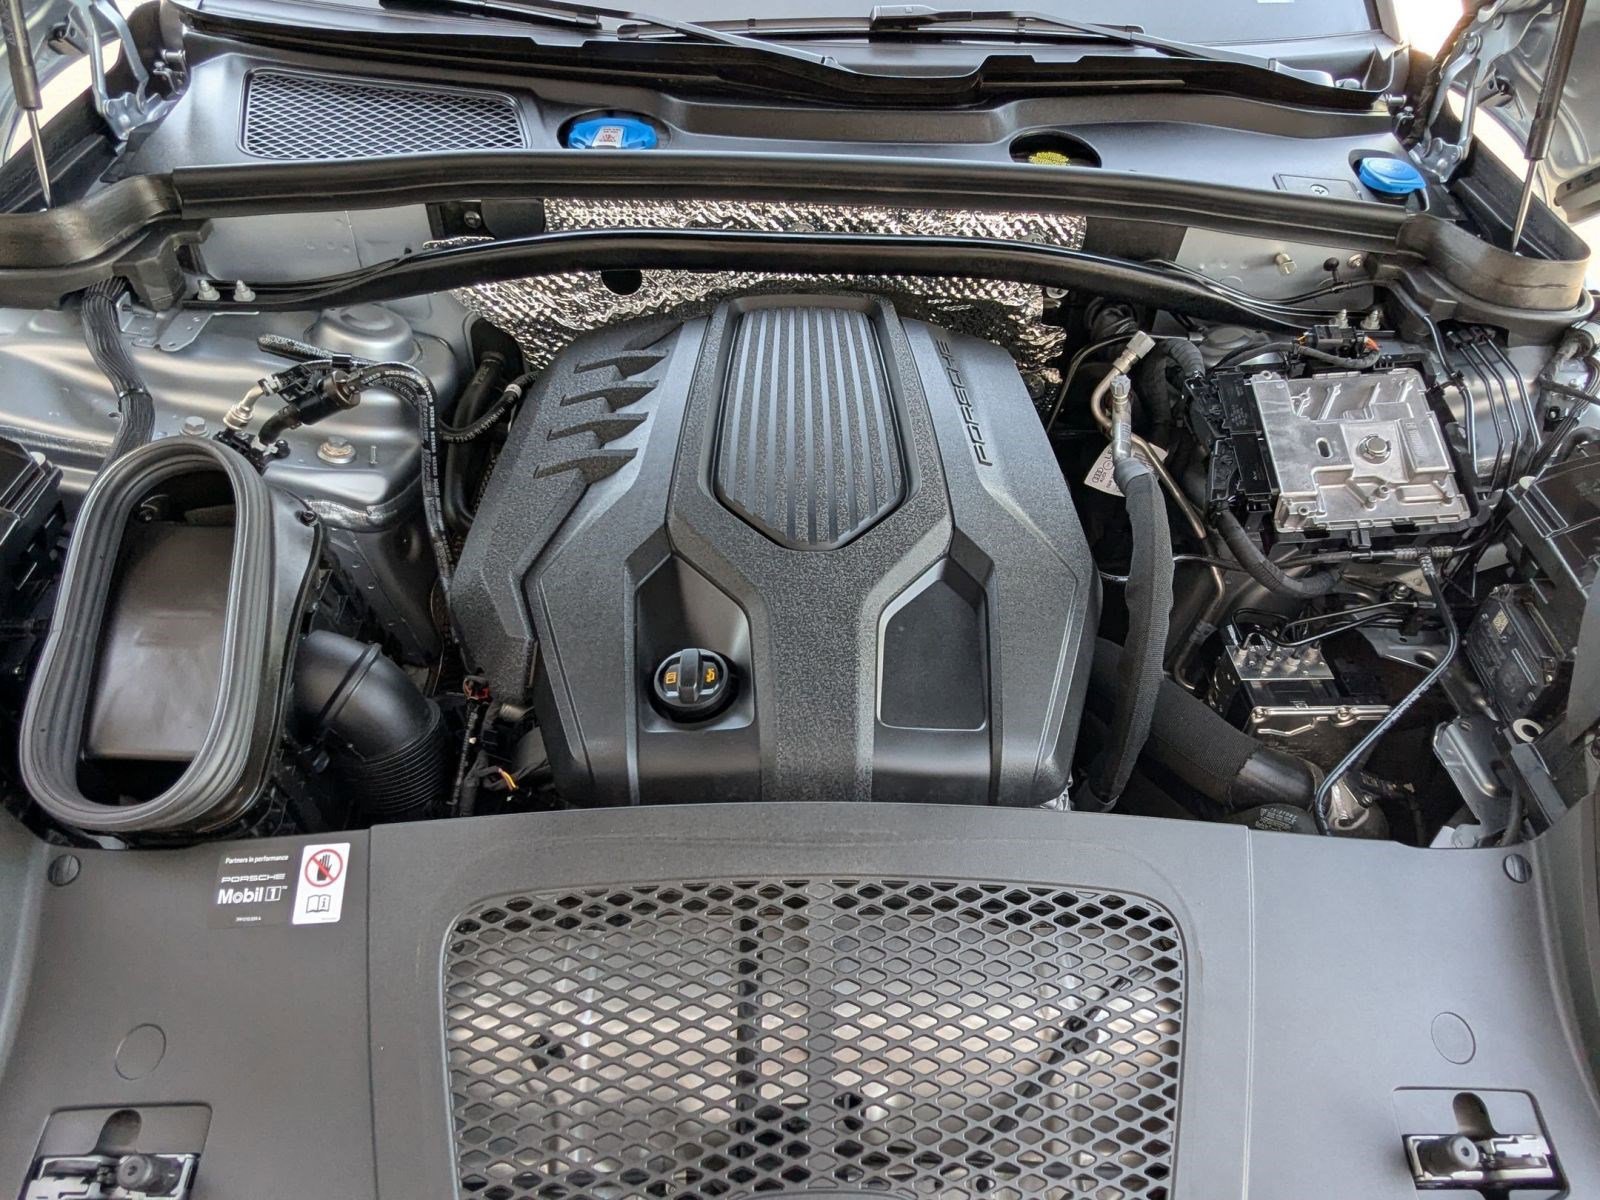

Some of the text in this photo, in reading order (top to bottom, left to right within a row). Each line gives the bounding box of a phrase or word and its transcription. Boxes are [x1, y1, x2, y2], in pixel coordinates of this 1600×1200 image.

[936, 339, 993, 467] PORSCHE
[254, 855, 289, 864] performance
[221, 873, 286, 883] PORSCHE
[217, 887, 264, 904] Mobil
